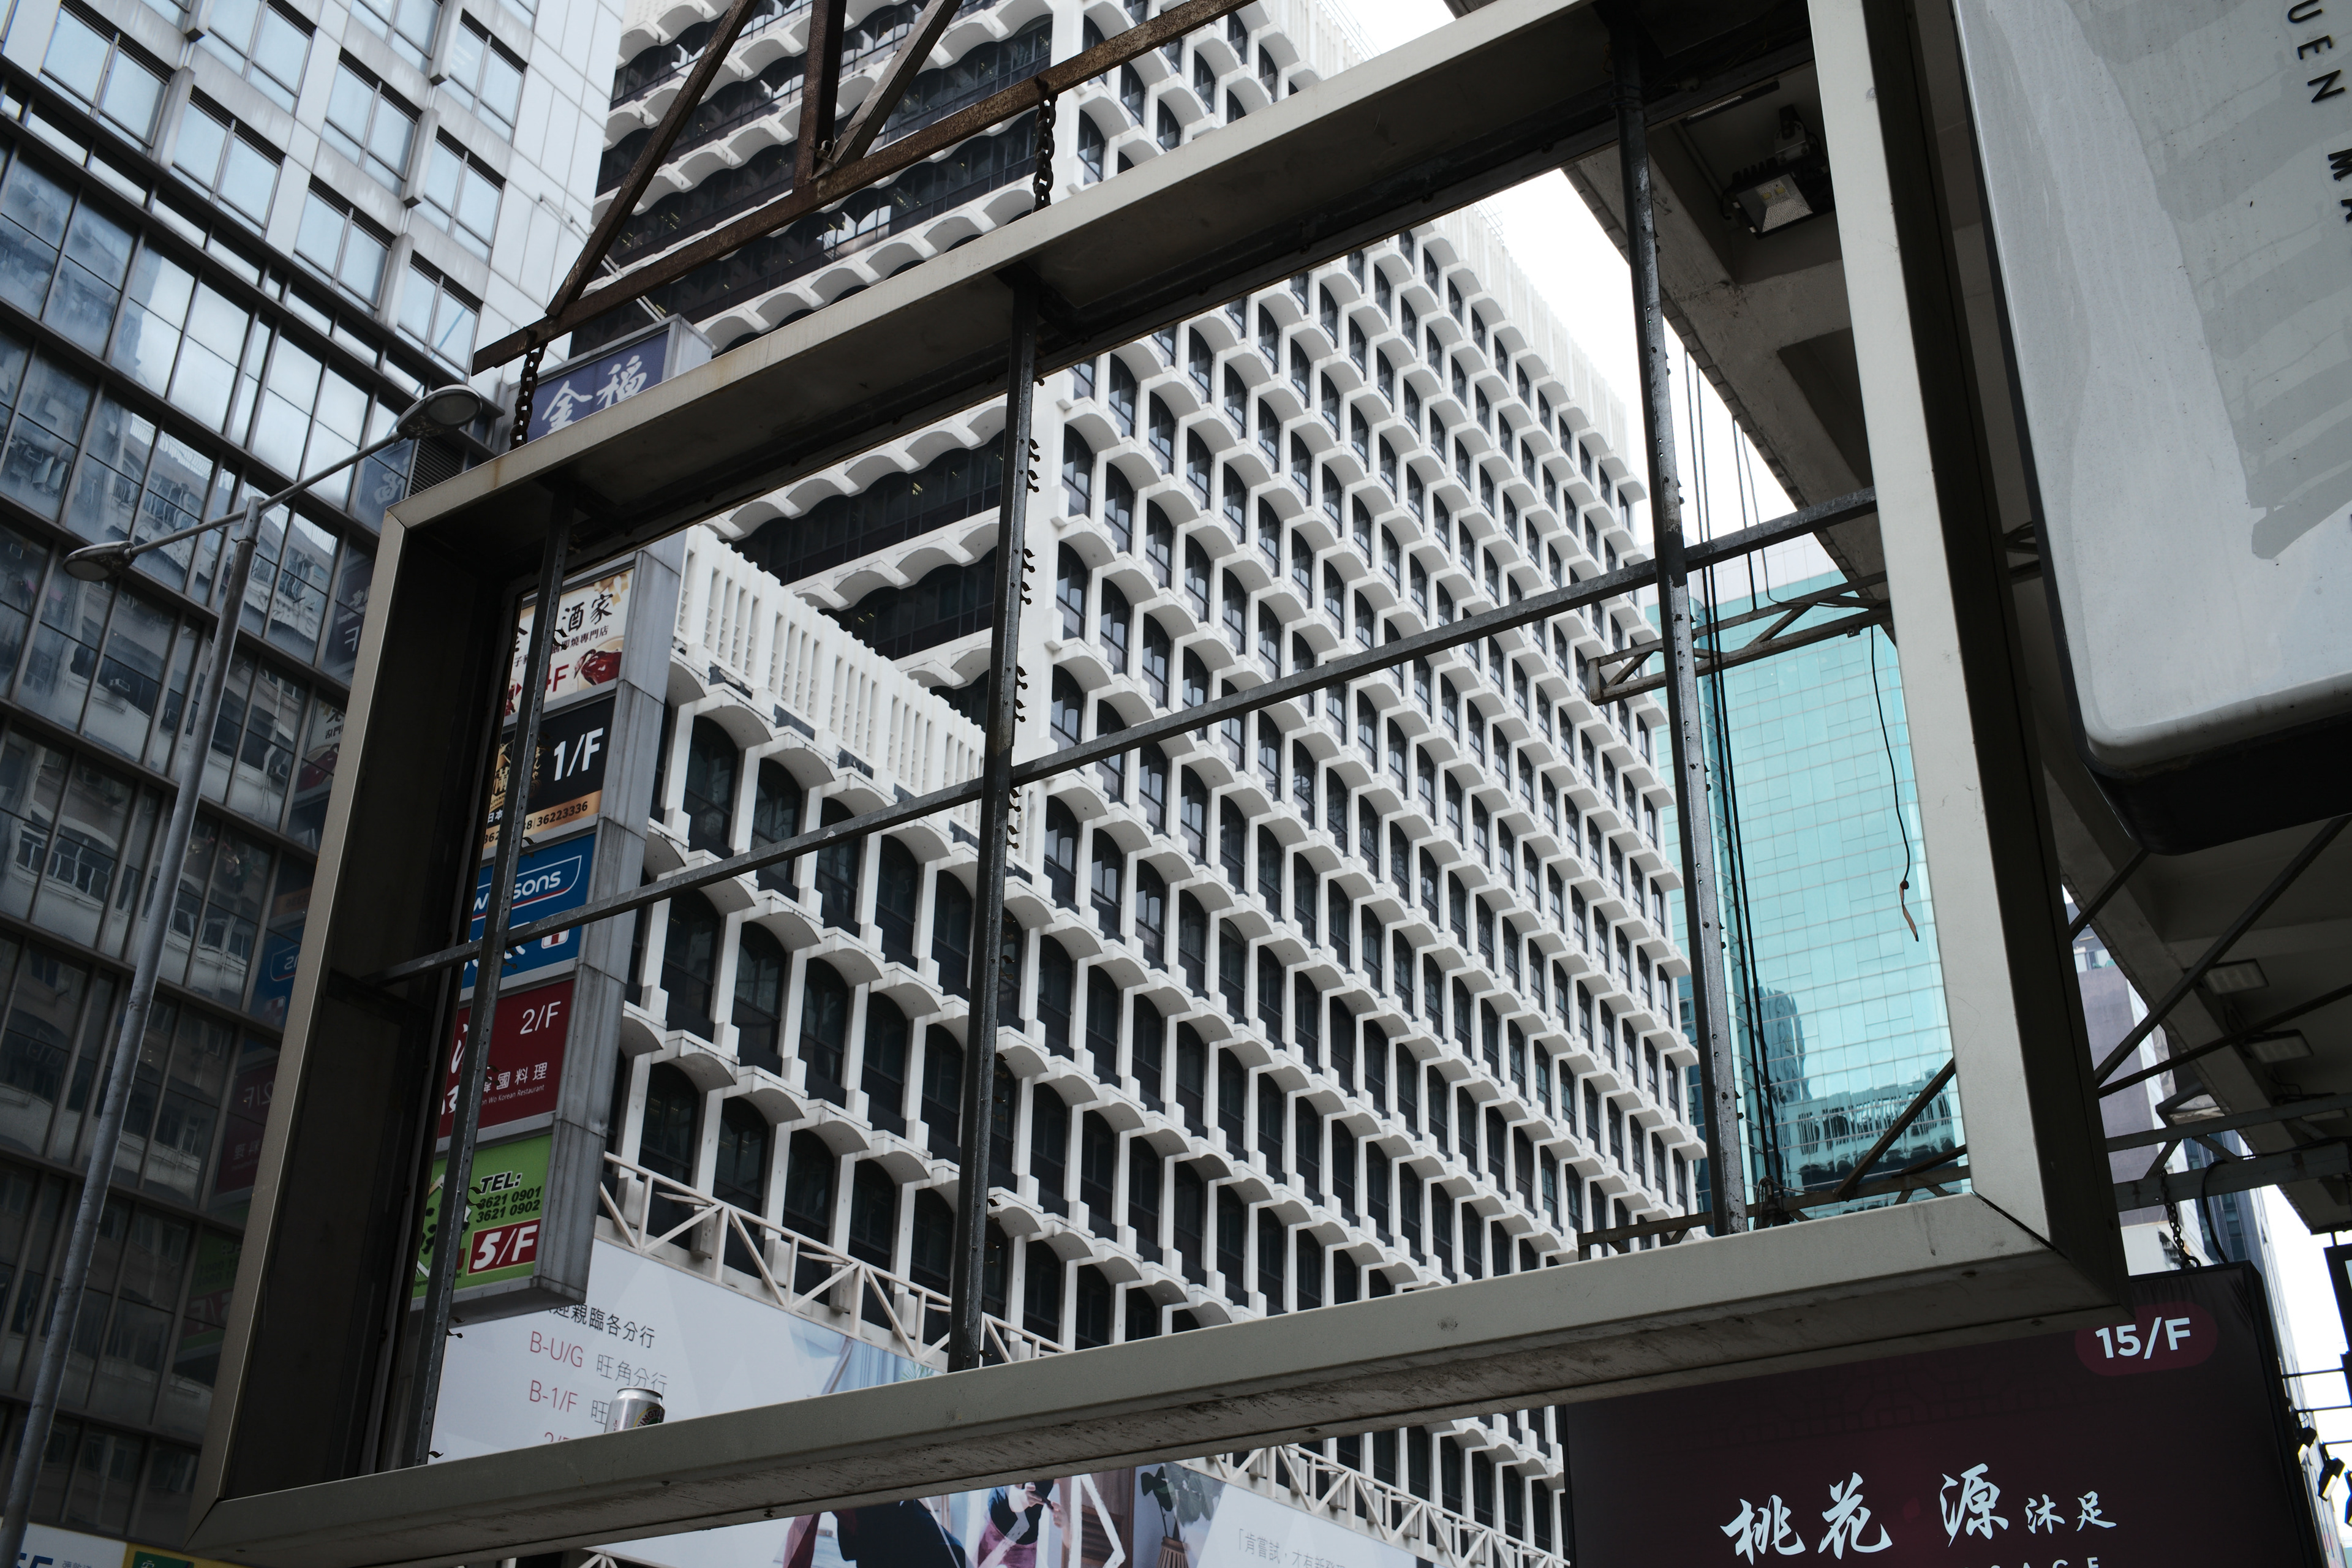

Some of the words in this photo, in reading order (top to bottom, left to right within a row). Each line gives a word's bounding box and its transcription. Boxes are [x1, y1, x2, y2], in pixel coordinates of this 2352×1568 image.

[554, 727, 604, 782] 1/F
[537, 801, 588, 826] 36223336
[472, 870, 562, 913] wsons
[520, 1000, 562, 1035] 2/F
[498, 1092, 516, 1102] Korean
[517, 1084, 545, 1096] Restaurant
[480, 1171, 522, 1194] TEL:
[480, 1193, 507, 1209] 3621
[511, 1185, 542, 1203] 0901
[476, 1208, 506, 1223] 3621
[510, 1199, 541, 1216] 0902
[472, 1224, 538, 1270] 5/F
[548, 1303, 655, 1349] 迎親臨各分行
[2095, 1316, 2194, 1361] 15/F
[529, 1330, 584, 1368] B-U/G
[529, 1379, 578, 1413] B-1/F
[1720, 1462, 2010, 1566] 桃花源
[2026, 1490, 2117, 1534] 沐足
